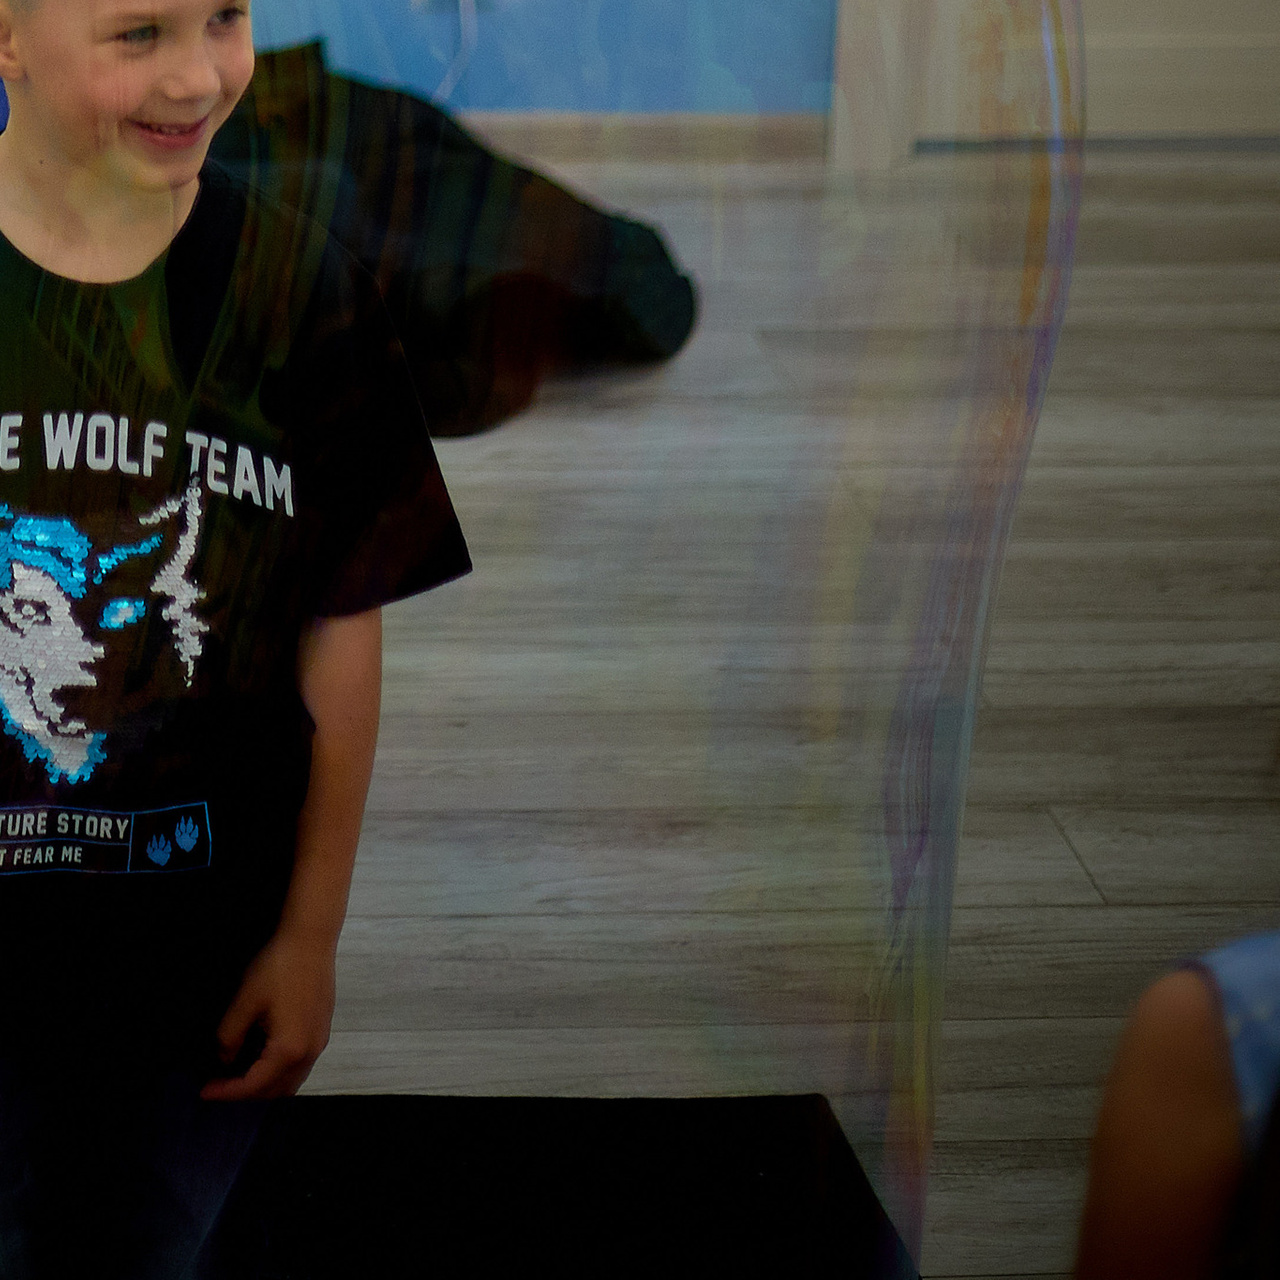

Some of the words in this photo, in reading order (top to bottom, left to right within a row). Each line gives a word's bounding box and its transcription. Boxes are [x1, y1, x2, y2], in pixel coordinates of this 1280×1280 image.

[42, 412, 168, 478] WOLF
[185, 431, 295, 517] TEAM
[57, 812, 130, 840] STORY
[13, 846, 55, 865] FEAR
[61, 845, 83, 864] ME
